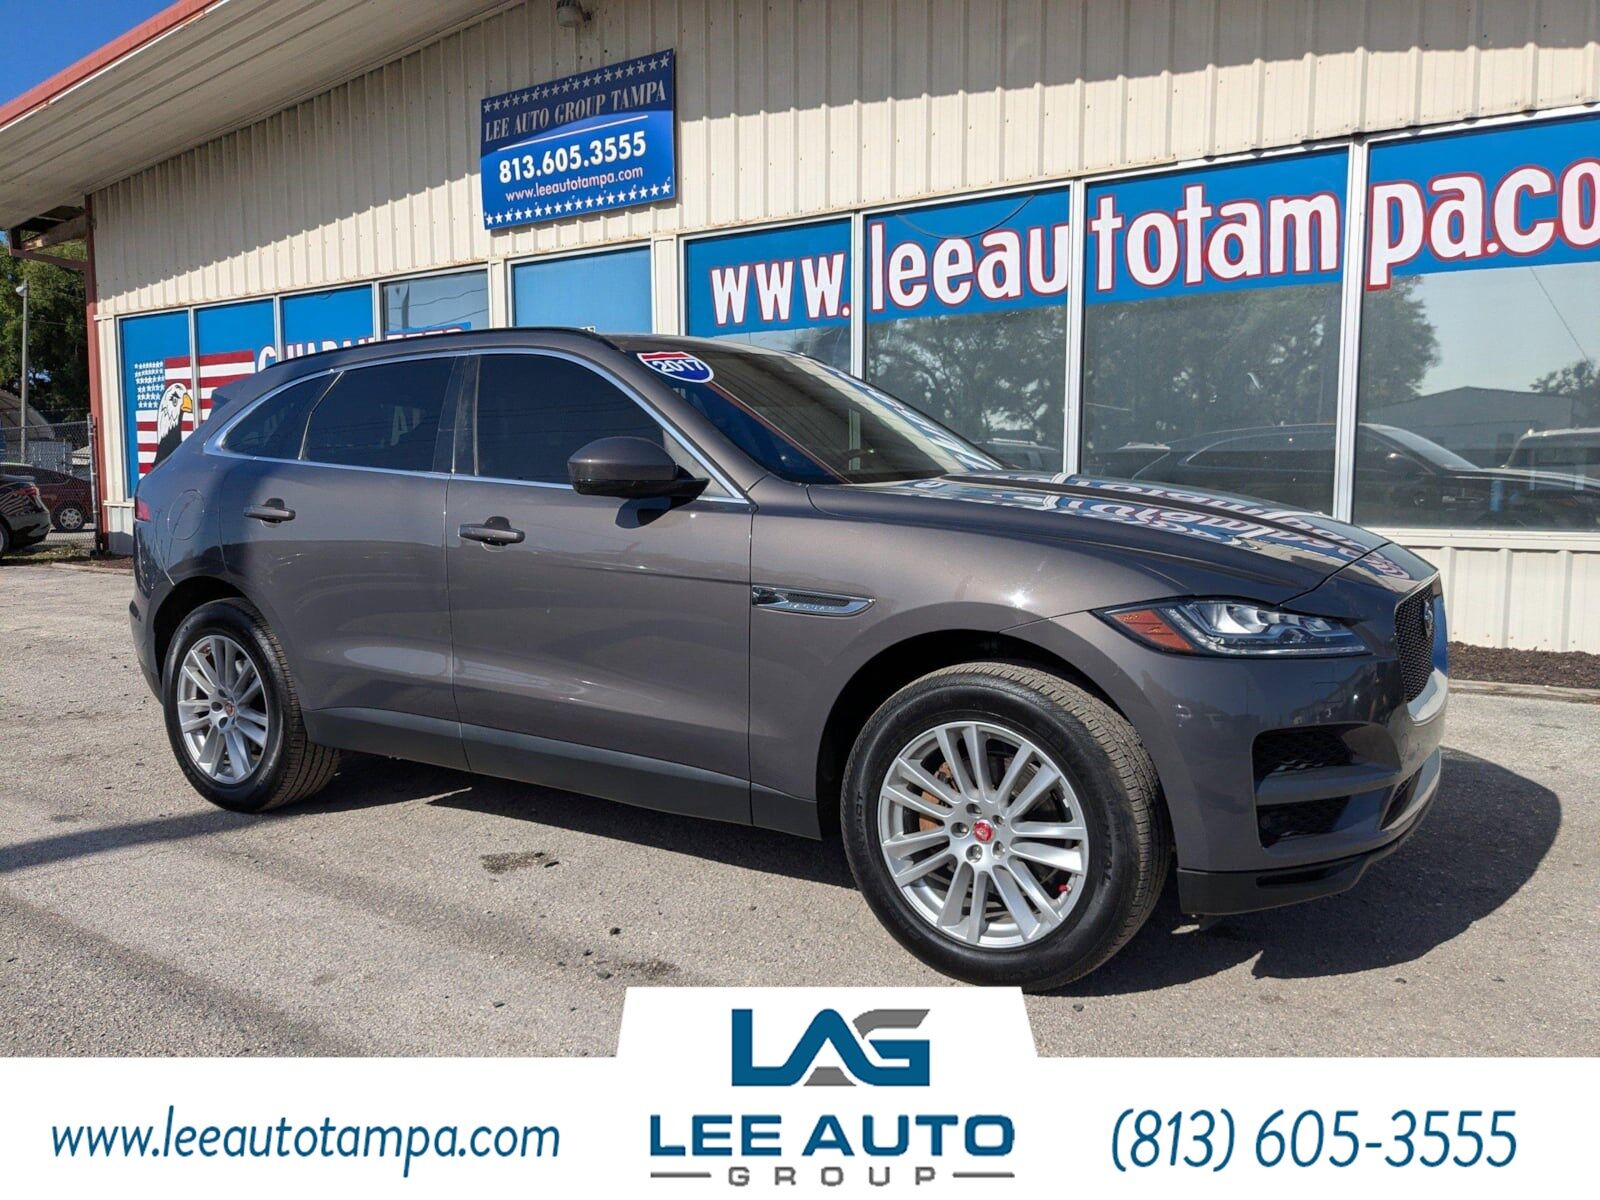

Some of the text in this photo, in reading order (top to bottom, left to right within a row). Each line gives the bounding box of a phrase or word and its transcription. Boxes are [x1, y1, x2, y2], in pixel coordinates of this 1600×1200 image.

[485, 79, 666, 142] LEE AUTO GROUP TAMPA
[499, 130, 646, 184] 813.605.3555
[505, 165, 643, 202] www.leeautotampa.com
[652, 359, 704, 373] 2017
